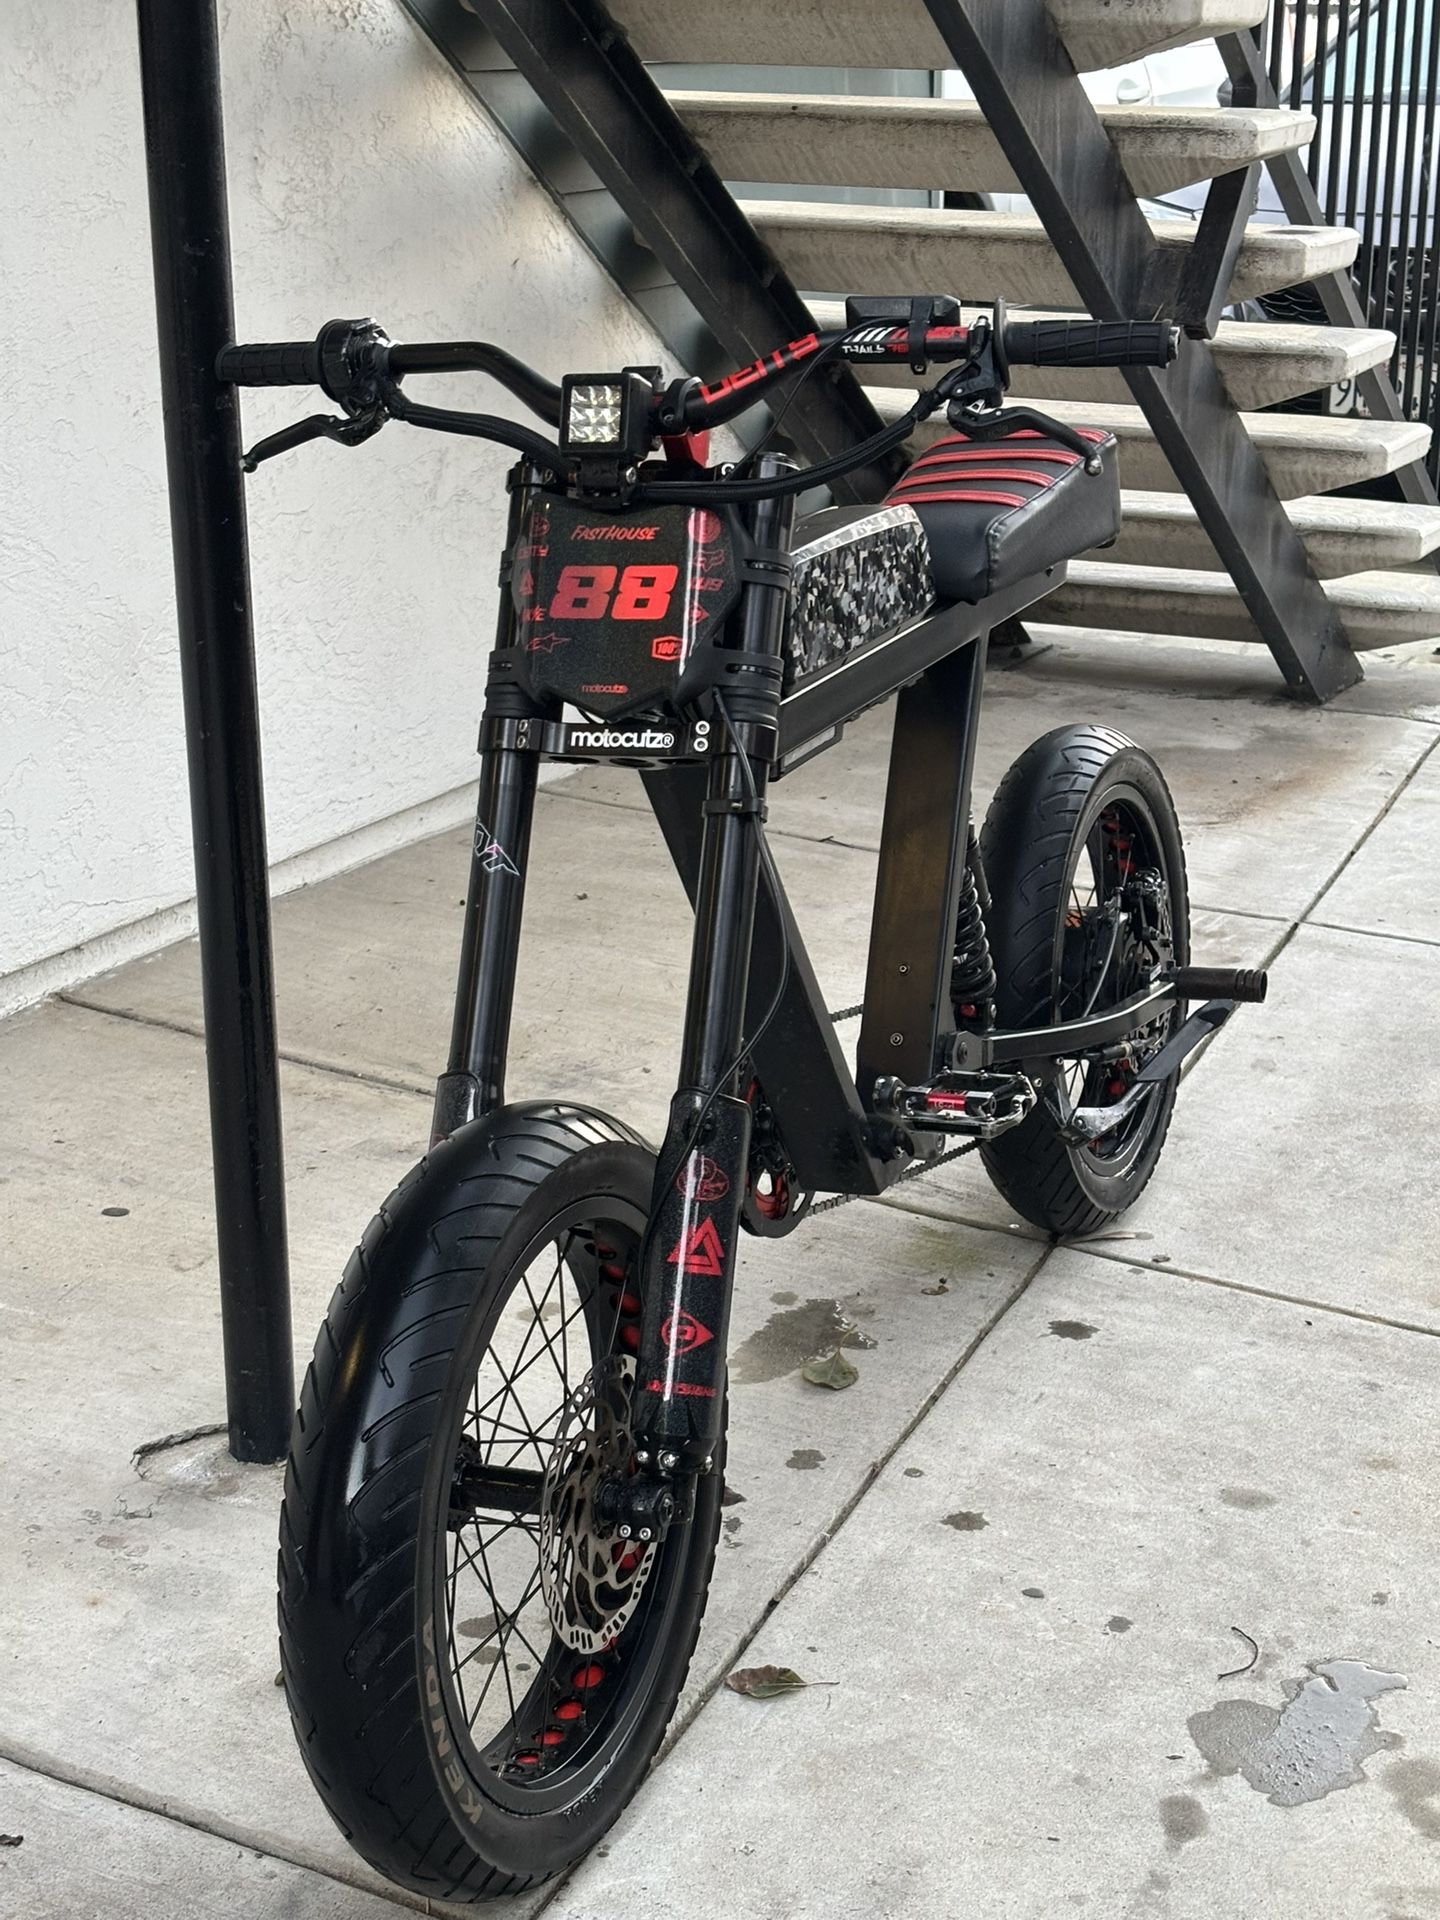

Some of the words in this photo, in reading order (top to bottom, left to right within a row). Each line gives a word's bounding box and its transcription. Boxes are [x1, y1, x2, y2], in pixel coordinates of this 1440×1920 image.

[570, 524, 661, 541] FASTHOUSE
[550, 565, 679, 620] 88
[422, 1612, 484, 1825] KENDA
